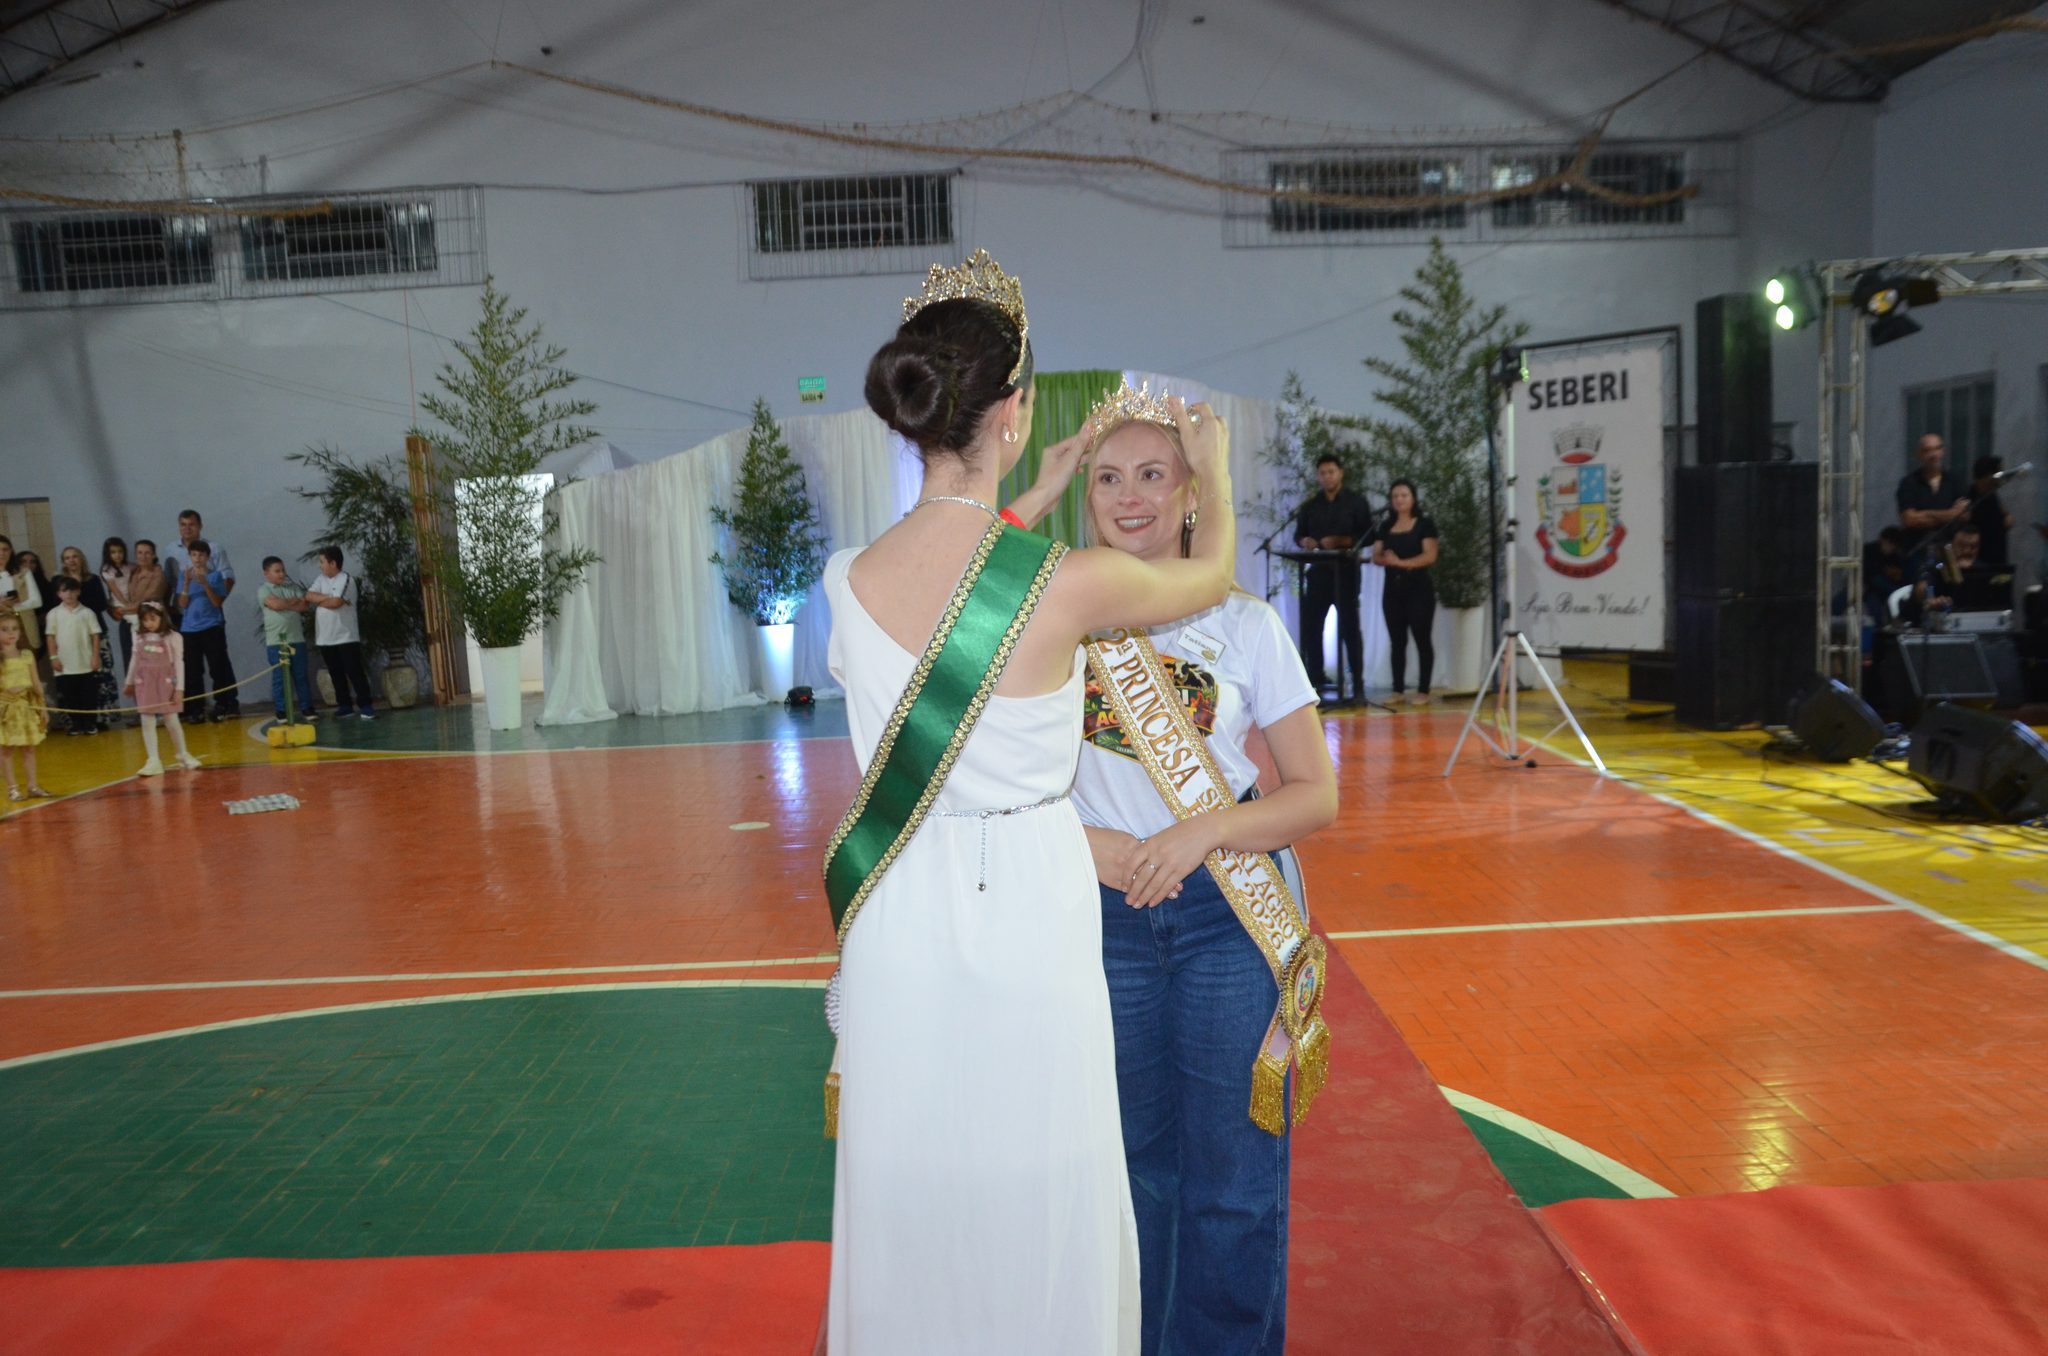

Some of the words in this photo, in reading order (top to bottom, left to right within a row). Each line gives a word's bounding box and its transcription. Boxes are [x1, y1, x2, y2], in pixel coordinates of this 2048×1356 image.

[1528, 368, 1629, 412] SEBERI
[1110, 652, 1201, 793] PRINCESA
[1236, 881, 1285, 950] 2026
[1252, 880, 1295, 940] AGRO
